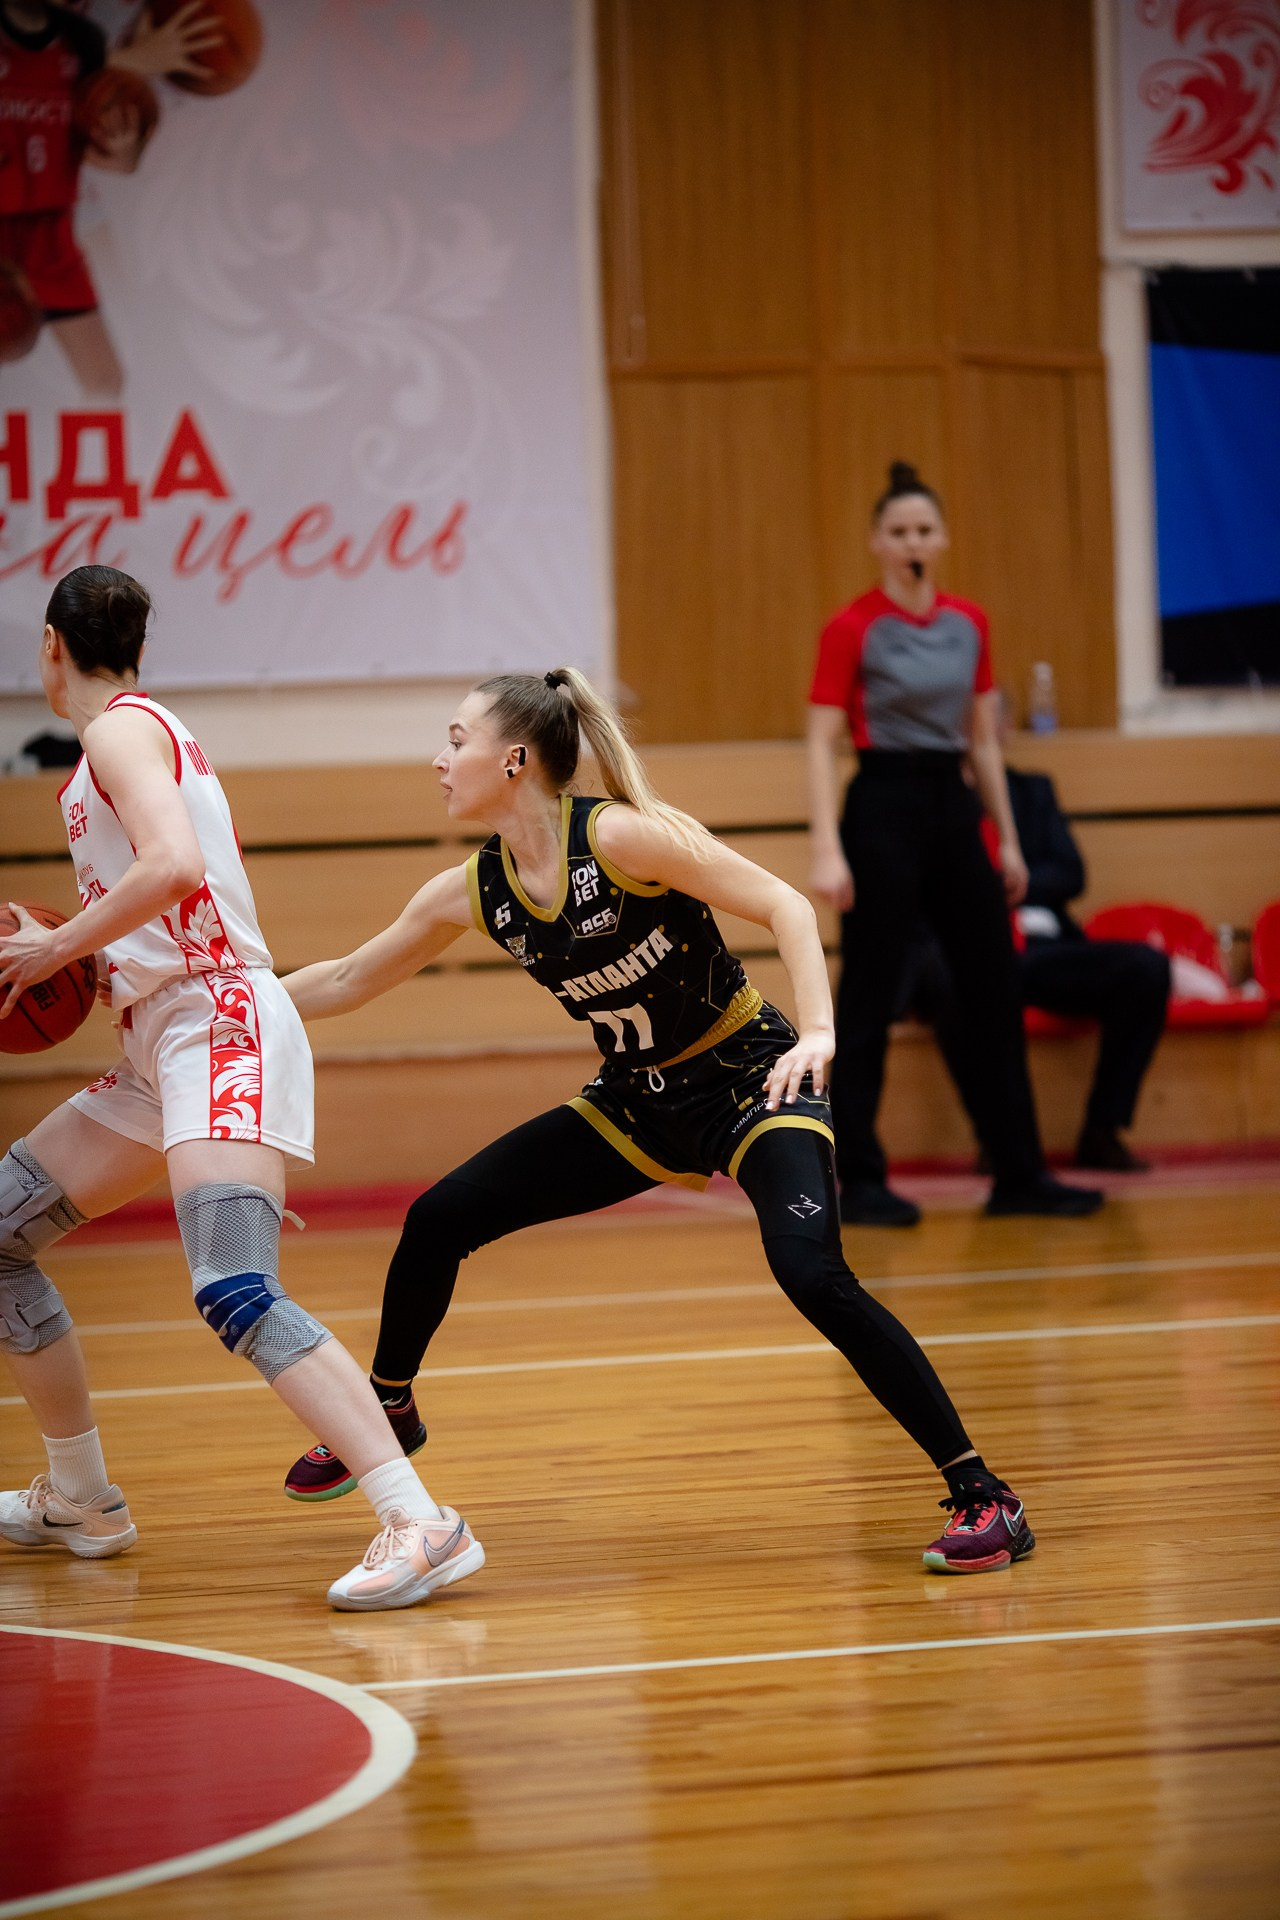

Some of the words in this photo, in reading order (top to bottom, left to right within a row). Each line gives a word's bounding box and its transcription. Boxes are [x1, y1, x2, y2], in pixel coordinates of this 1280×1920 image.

[69, 815, 88, 843] BET
[575, 877, 599, 907] BET
[548, 927, 674, 1002] -АТЛАНТА
